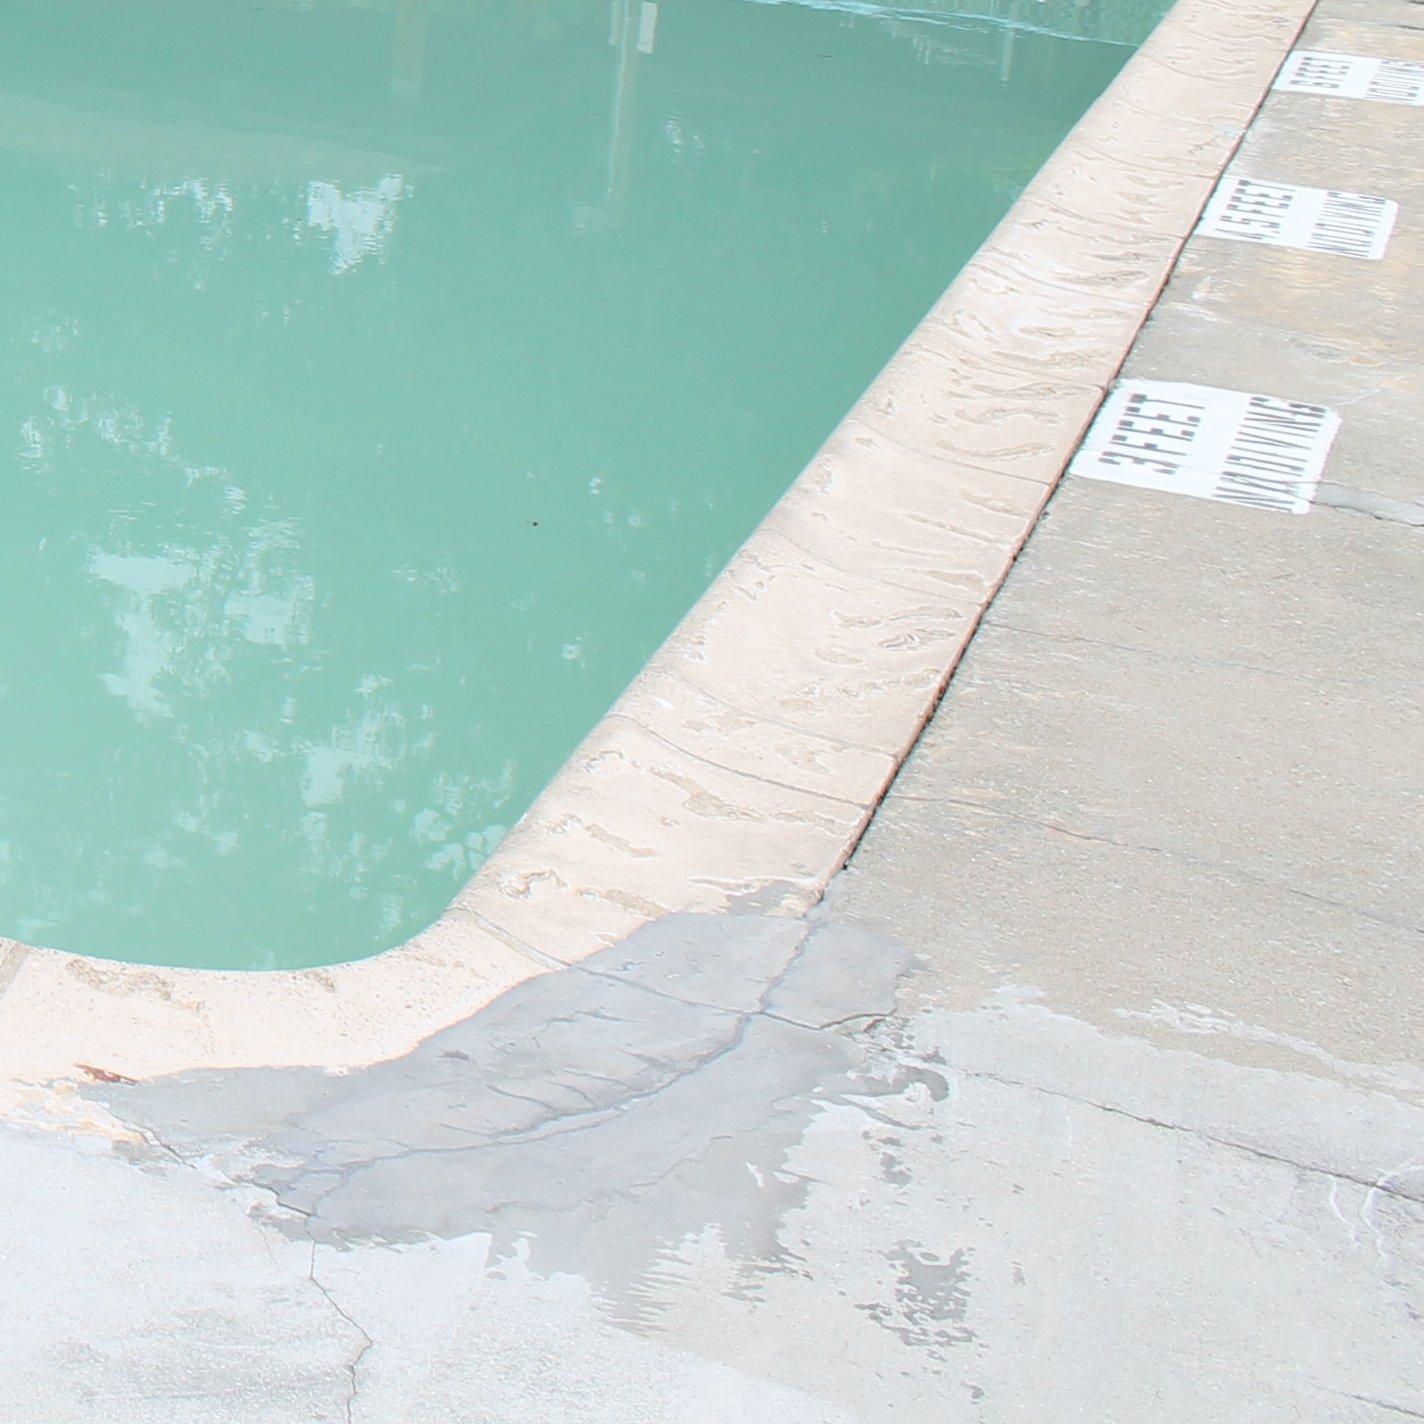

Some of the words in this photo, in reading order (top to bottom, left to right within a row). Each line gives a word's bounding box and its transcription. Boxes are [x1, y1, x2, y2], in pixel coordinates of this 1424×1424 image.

[1295, 56, 1352, 81] FEET
[1226, 179, 1296, 219] FEET
[1315, 191, 1386, 237] DIVING
[1307, 233, 1372, 258] NO
[1110, 393, 1205, 457] FEET
[1225, 396, 1326, 477] DIVING
[1098, 449, 1180, 475] 3
[1212, 469, 1297, 513] NO
